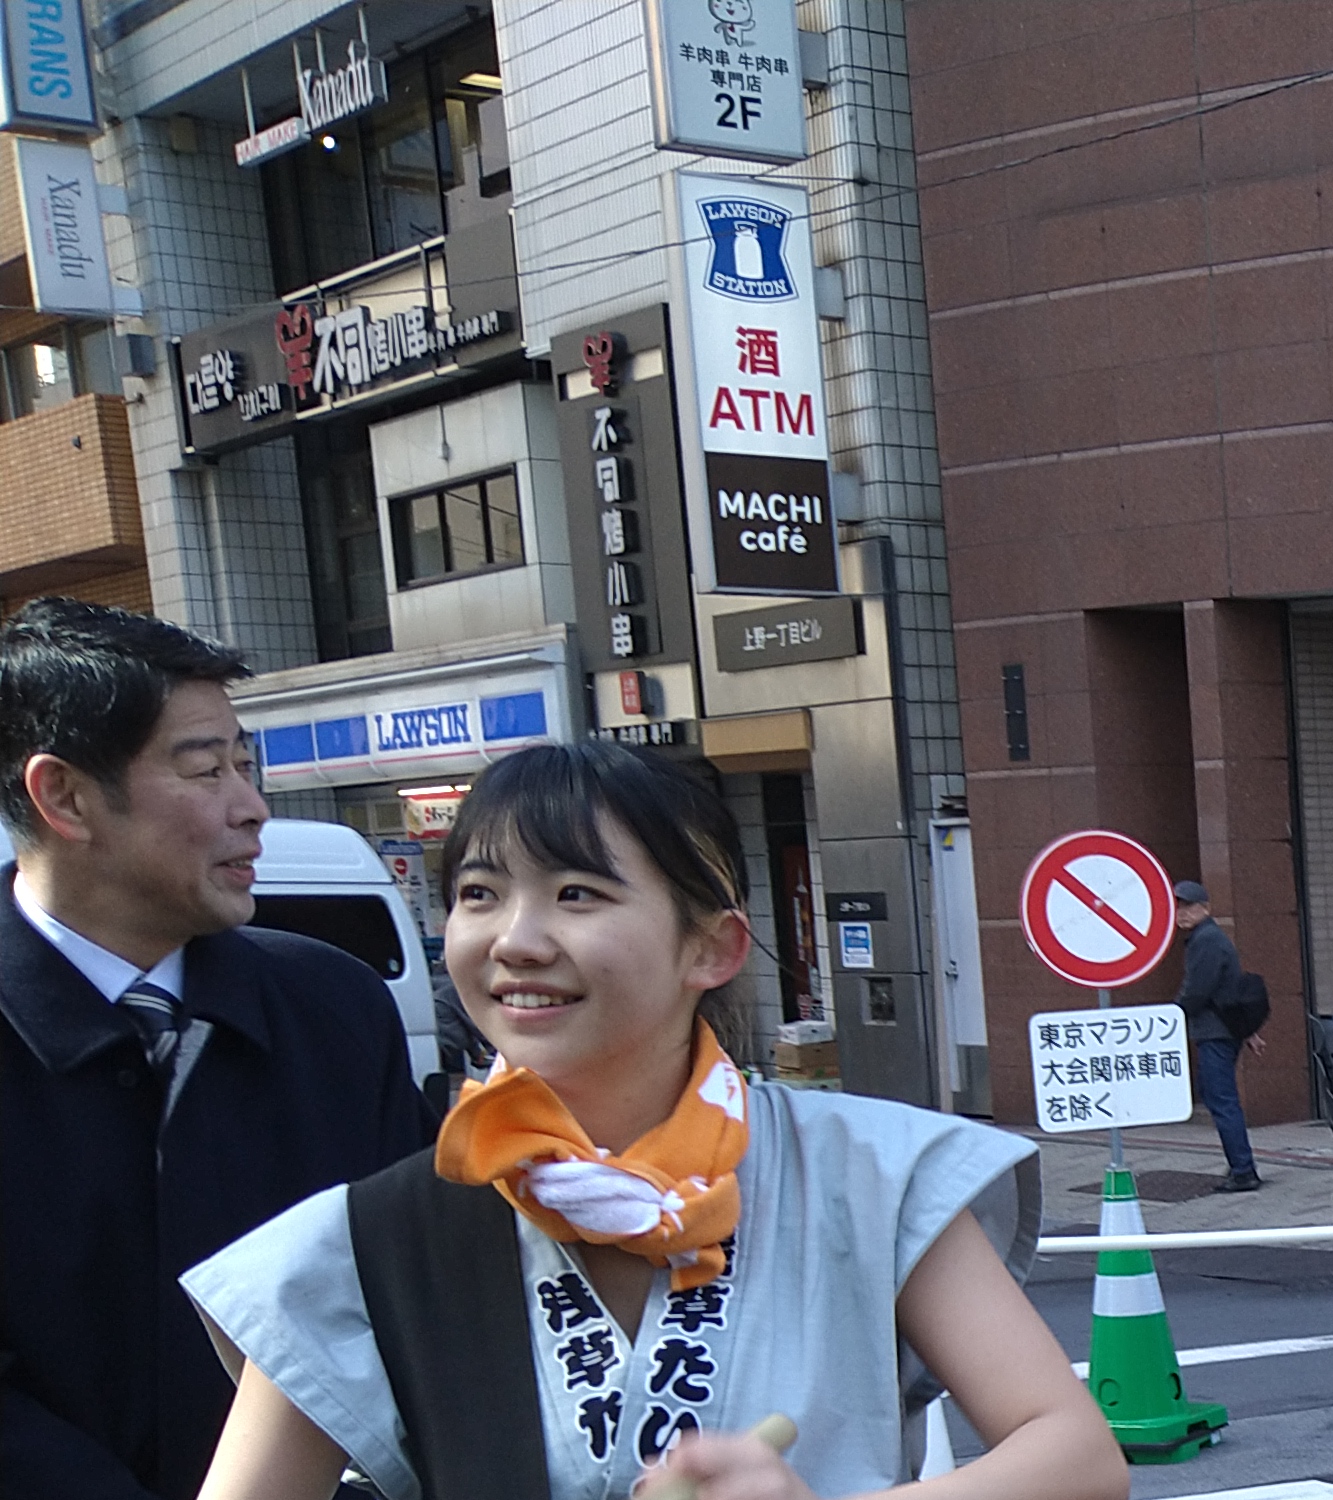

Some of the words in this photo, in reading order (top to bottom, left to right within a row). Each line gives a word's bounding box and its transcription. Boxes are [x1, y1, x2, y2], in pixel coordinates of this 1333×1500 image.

[679, 42, 730, 67] 羊肉串
[738, 52, 789, 76] 牛肉串
[298, 39, 374, 132] Xanadu
[714, 92, 762, 131] 2F
[47, 174, 94, 280] Xanadu
[705, 202, 784, 230] LAWSON
[712, 271, 788, 297] STATION
[735, 325, 781, 377] 酒
[708, 386, 816, 437] ATM
[718, 489, 823, 525] MACHI
[740, 525, 808, 554] café
[742, 618, 823, 651] 上野一丁目ビル
[374, 703, 472, 751] LAWSON
[1037, 1016, 1179, 1050] 東京マラソン
[1041, 1050, 1182, 1087] 大会関係車両
[1046, 1092, 1114, 1123] を除く
